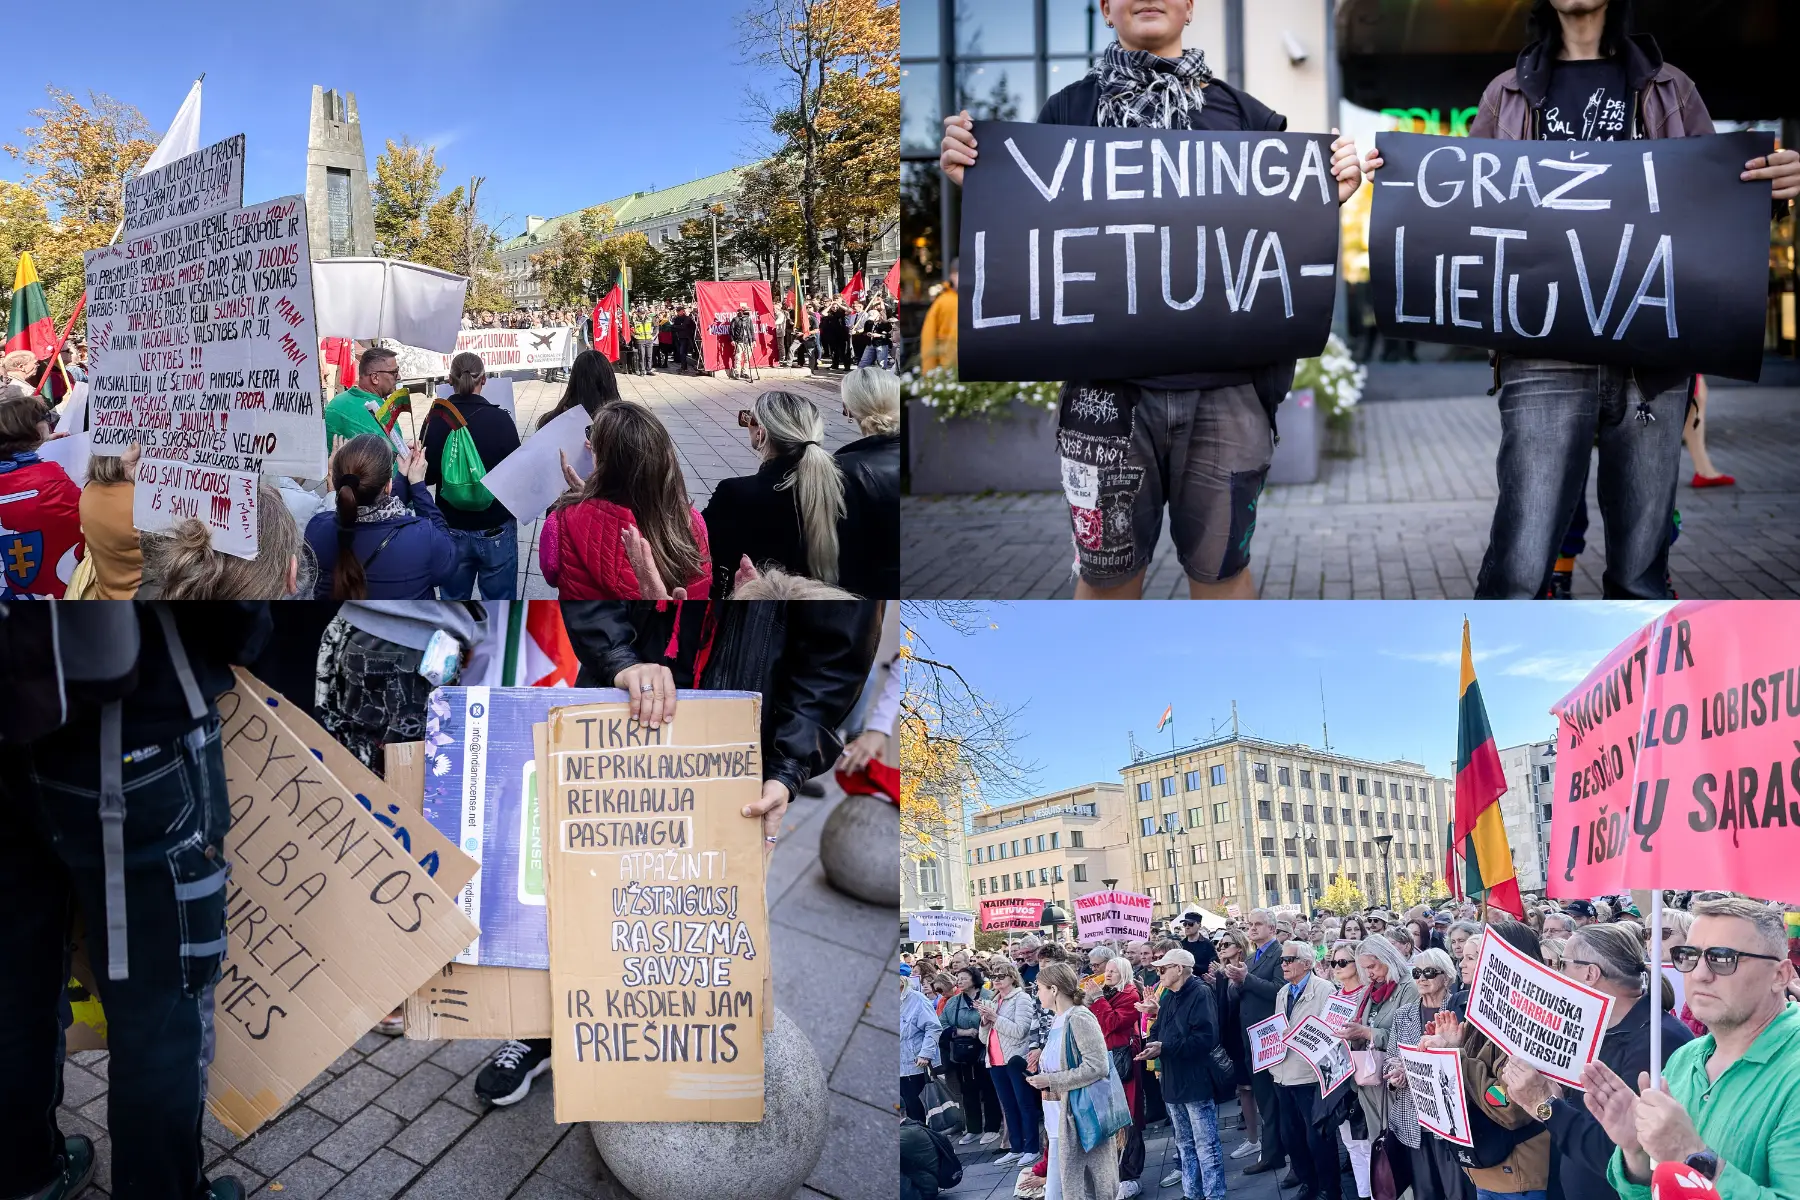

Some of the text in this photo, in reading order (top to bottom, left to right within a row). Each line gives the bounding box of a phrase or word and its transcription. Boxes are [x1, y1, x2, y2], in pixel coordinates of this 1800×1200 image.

[1004, 138, 1331, 205] VIENINGA
[288, 213, 299, 237] IR
[256, 243, 298, 270] JUODUS
[1395, 223, 1679, 340] LIETUVA
[258, 296, 269, 315] IR
[275, 295, 305, 328] MANI
[241, 319, 252, 339] IR
[278, 332, 308, 367] MANI
[248, 369, 280, 389] KERTA
[288, 370, 300, 390] IR
[272, 391, 313, 416] NAIKINA
[233, 432, 276, 455] VELNIO
[138, 463, 157, 484] KAD
[152, 487, 163, 511] IŠ
[1656, 620, 1694, 675] IR
[576, 718, 661, 748] TIKRA
[468, 727, 481, 828] info@indianincense.net
[566, 744, 759, 781] NEPRIKLAUSOMYBĖ
[567, 787, 694, 815] REIKALAUJA
[569, 820, 686, 848] PASTANGŲ
[228, 793, 328, 915] ALBA
[620, 849, 727, 881] ATPAŽINTI
[612, 881, 738, 919] UŽSTRIGUSĮ
[984, 898, 1024, 908] NAIKINTI
[991, 907, 1035, 915] LIETUVOS
[986, 919, 1040, 929] AGENTŪRAS
[611, 920, 757, 960] RASIZMĄ
[622, 956, 731, 987] SAVYJE
[567, 989, 753, 1018] IR KASDIEN JAM
[1482, 966, 1584, 1041] LIETUVA SVARBIAU NEI
[1488, 953, 1583, 1023] SAUGI IR LIETUVIŠKA
[1478, 1000, 1571, 1069] DARBO JĖGA VERSLUI
[1480, 984, 1578, 1057] PIGI, NEKVALIFIKUOTA
[574, 1020, 739, 1064] PRIEŠINTIS
